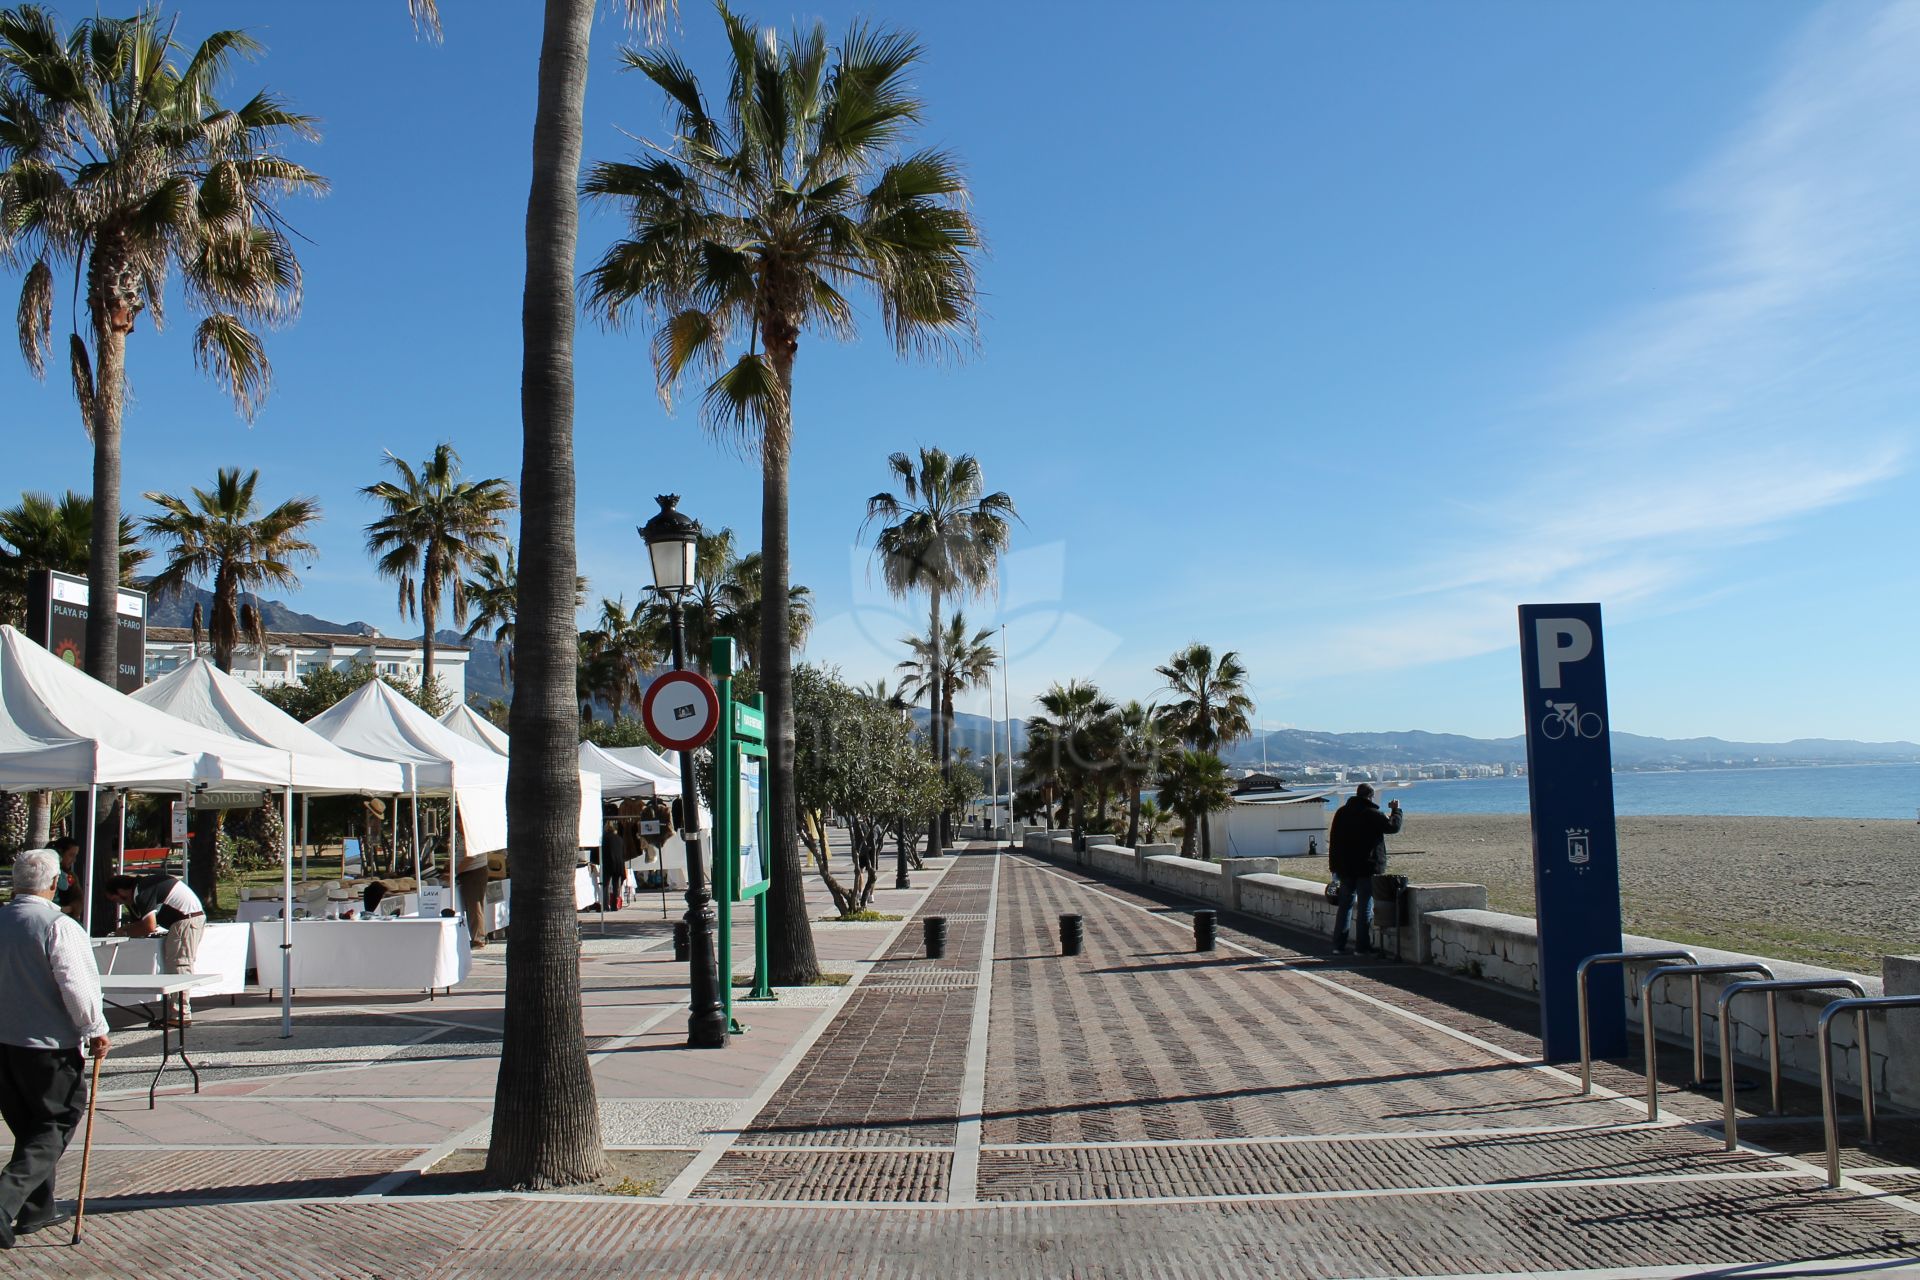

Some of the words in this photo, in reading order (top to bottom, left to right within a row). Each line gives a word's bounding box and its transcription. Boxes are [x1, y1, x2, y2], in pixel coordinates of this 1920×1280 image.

[54, 604, 76, 619] PLAYA
[79, 610, 88, 620] FO
[117, 619, 141, 630] A-FARO
[1535, 617, 1593, 689] P
[119, 663, 136, 676] SUN
